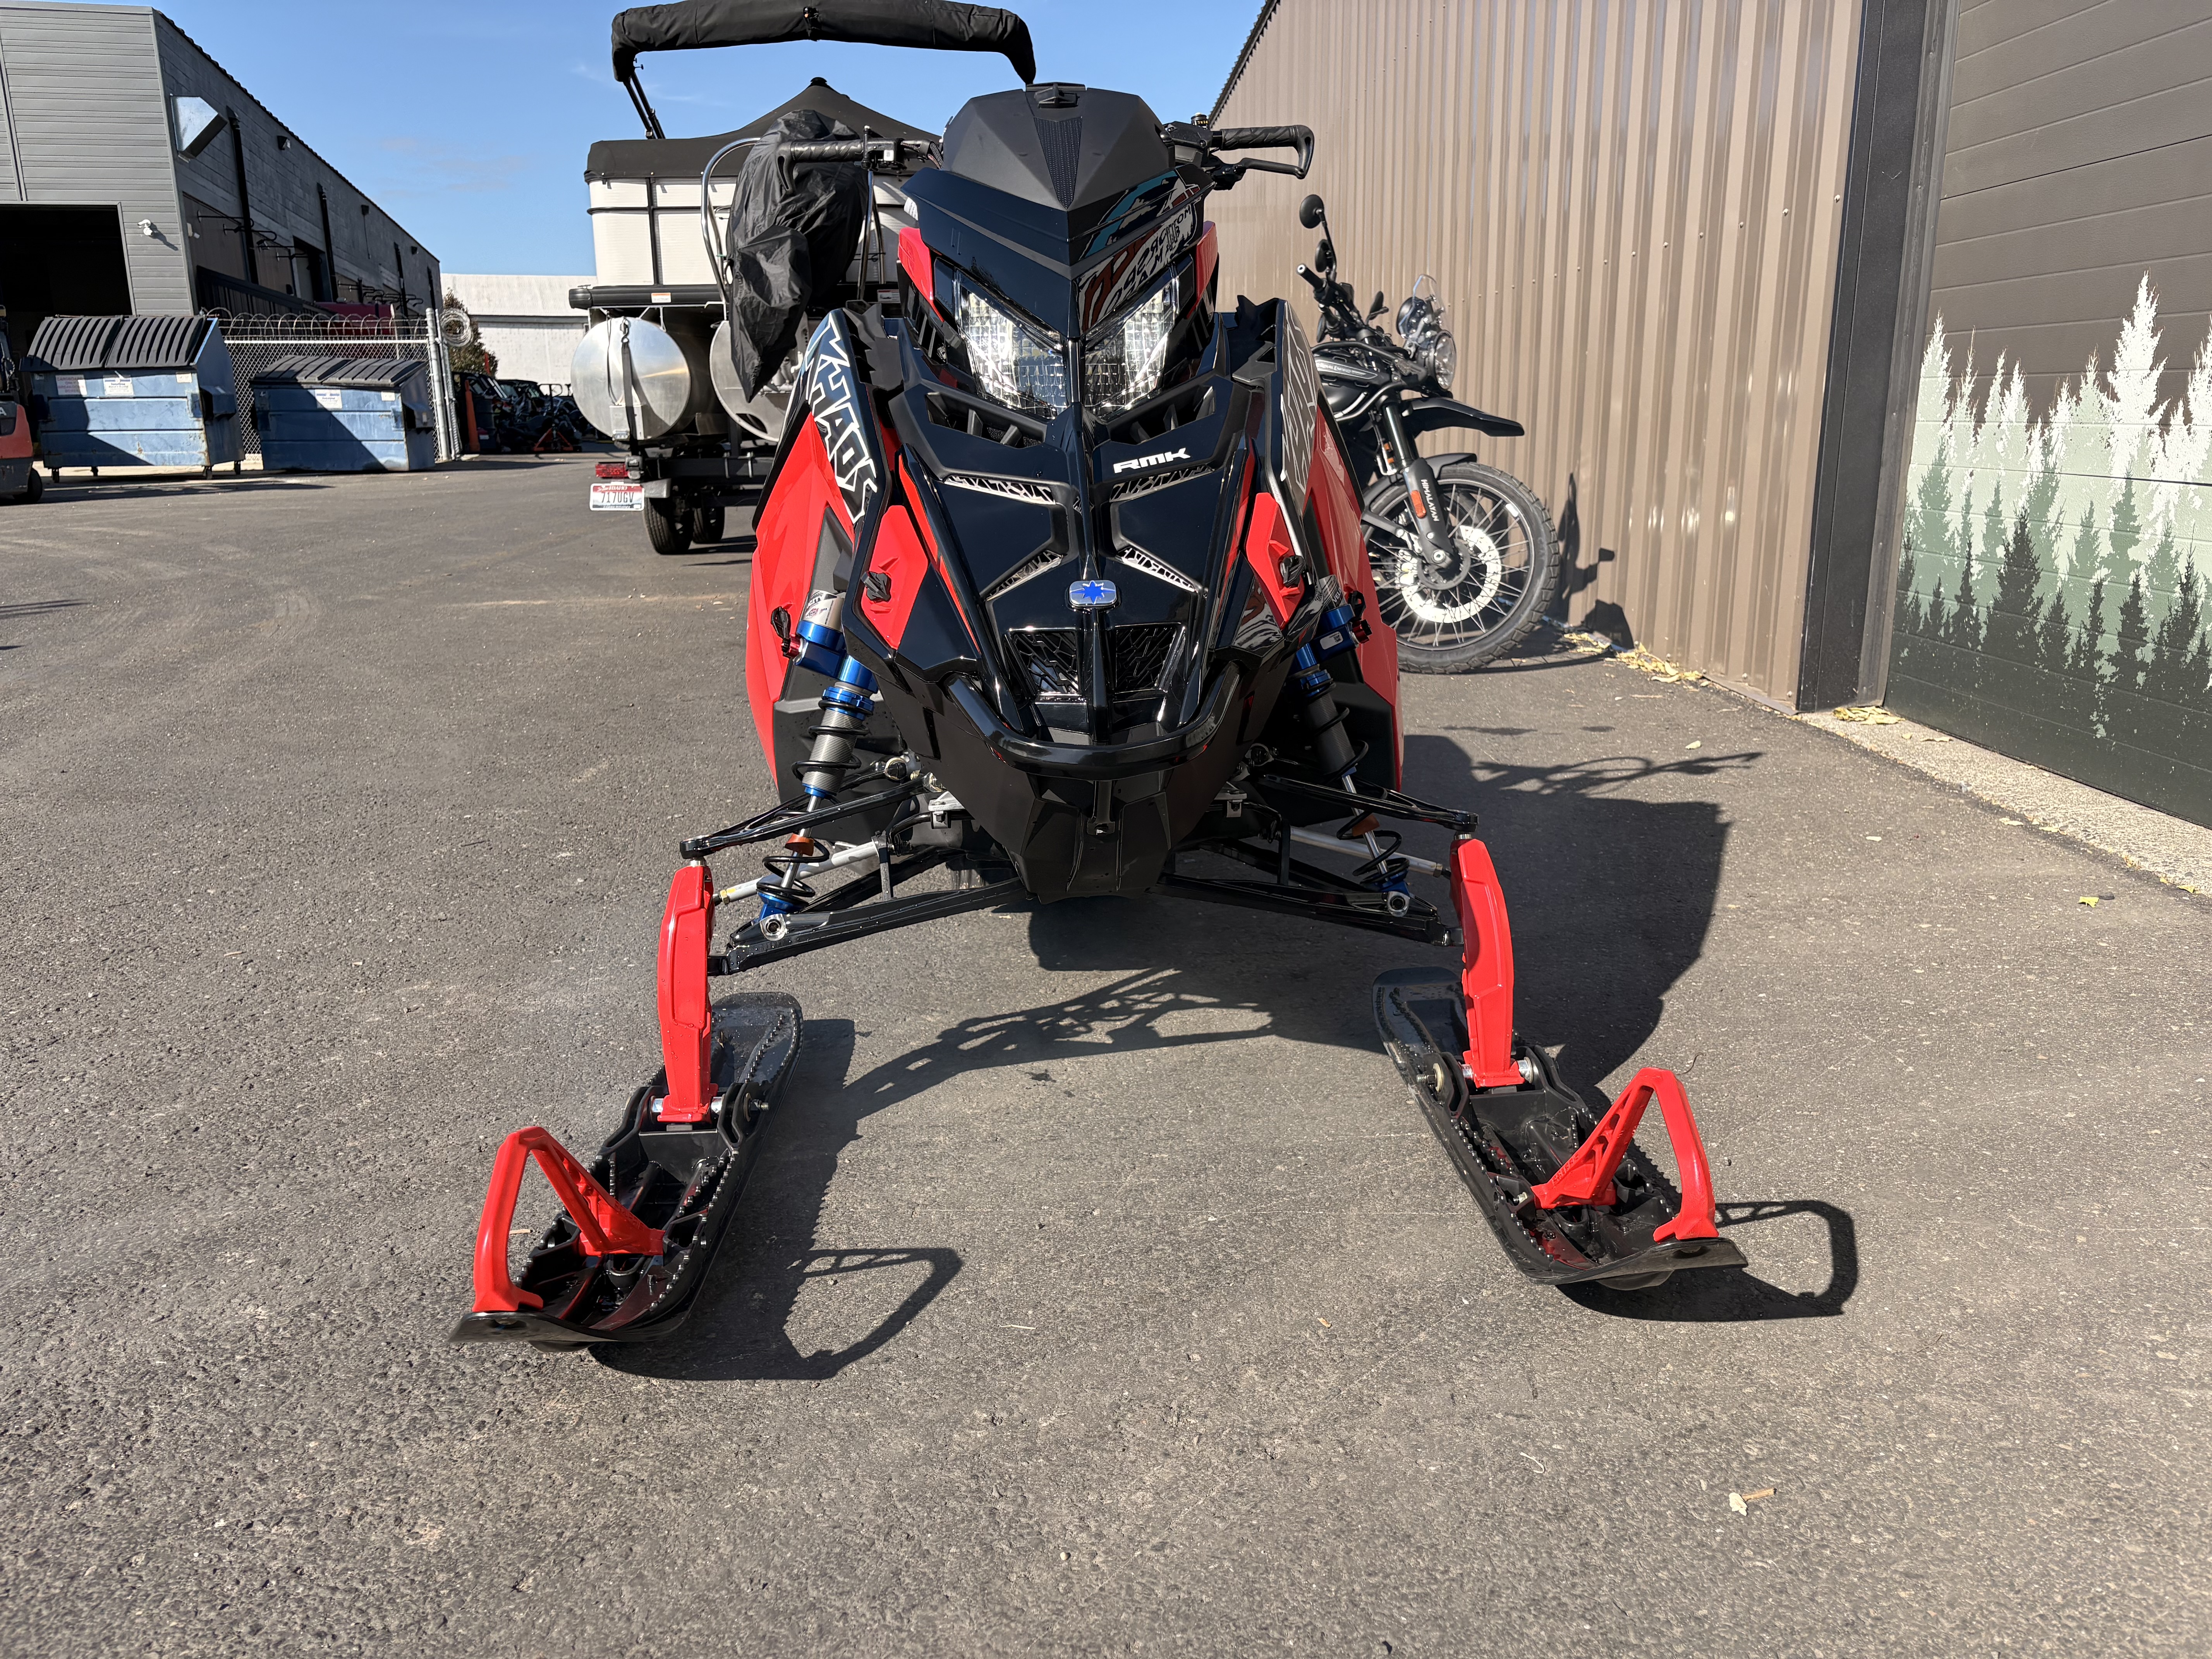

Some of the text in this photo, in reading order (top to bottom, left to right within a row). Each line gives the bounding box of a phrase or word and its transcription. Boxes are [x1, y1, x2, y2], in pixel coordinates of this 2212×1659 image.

[805, 312, 877, 524] KHAOS
[1113, 448, 1191, 473] RMK
[601, 492, 634, 503] 717UGV
[1421, 479, 1439, 521] HIMALAYAN
